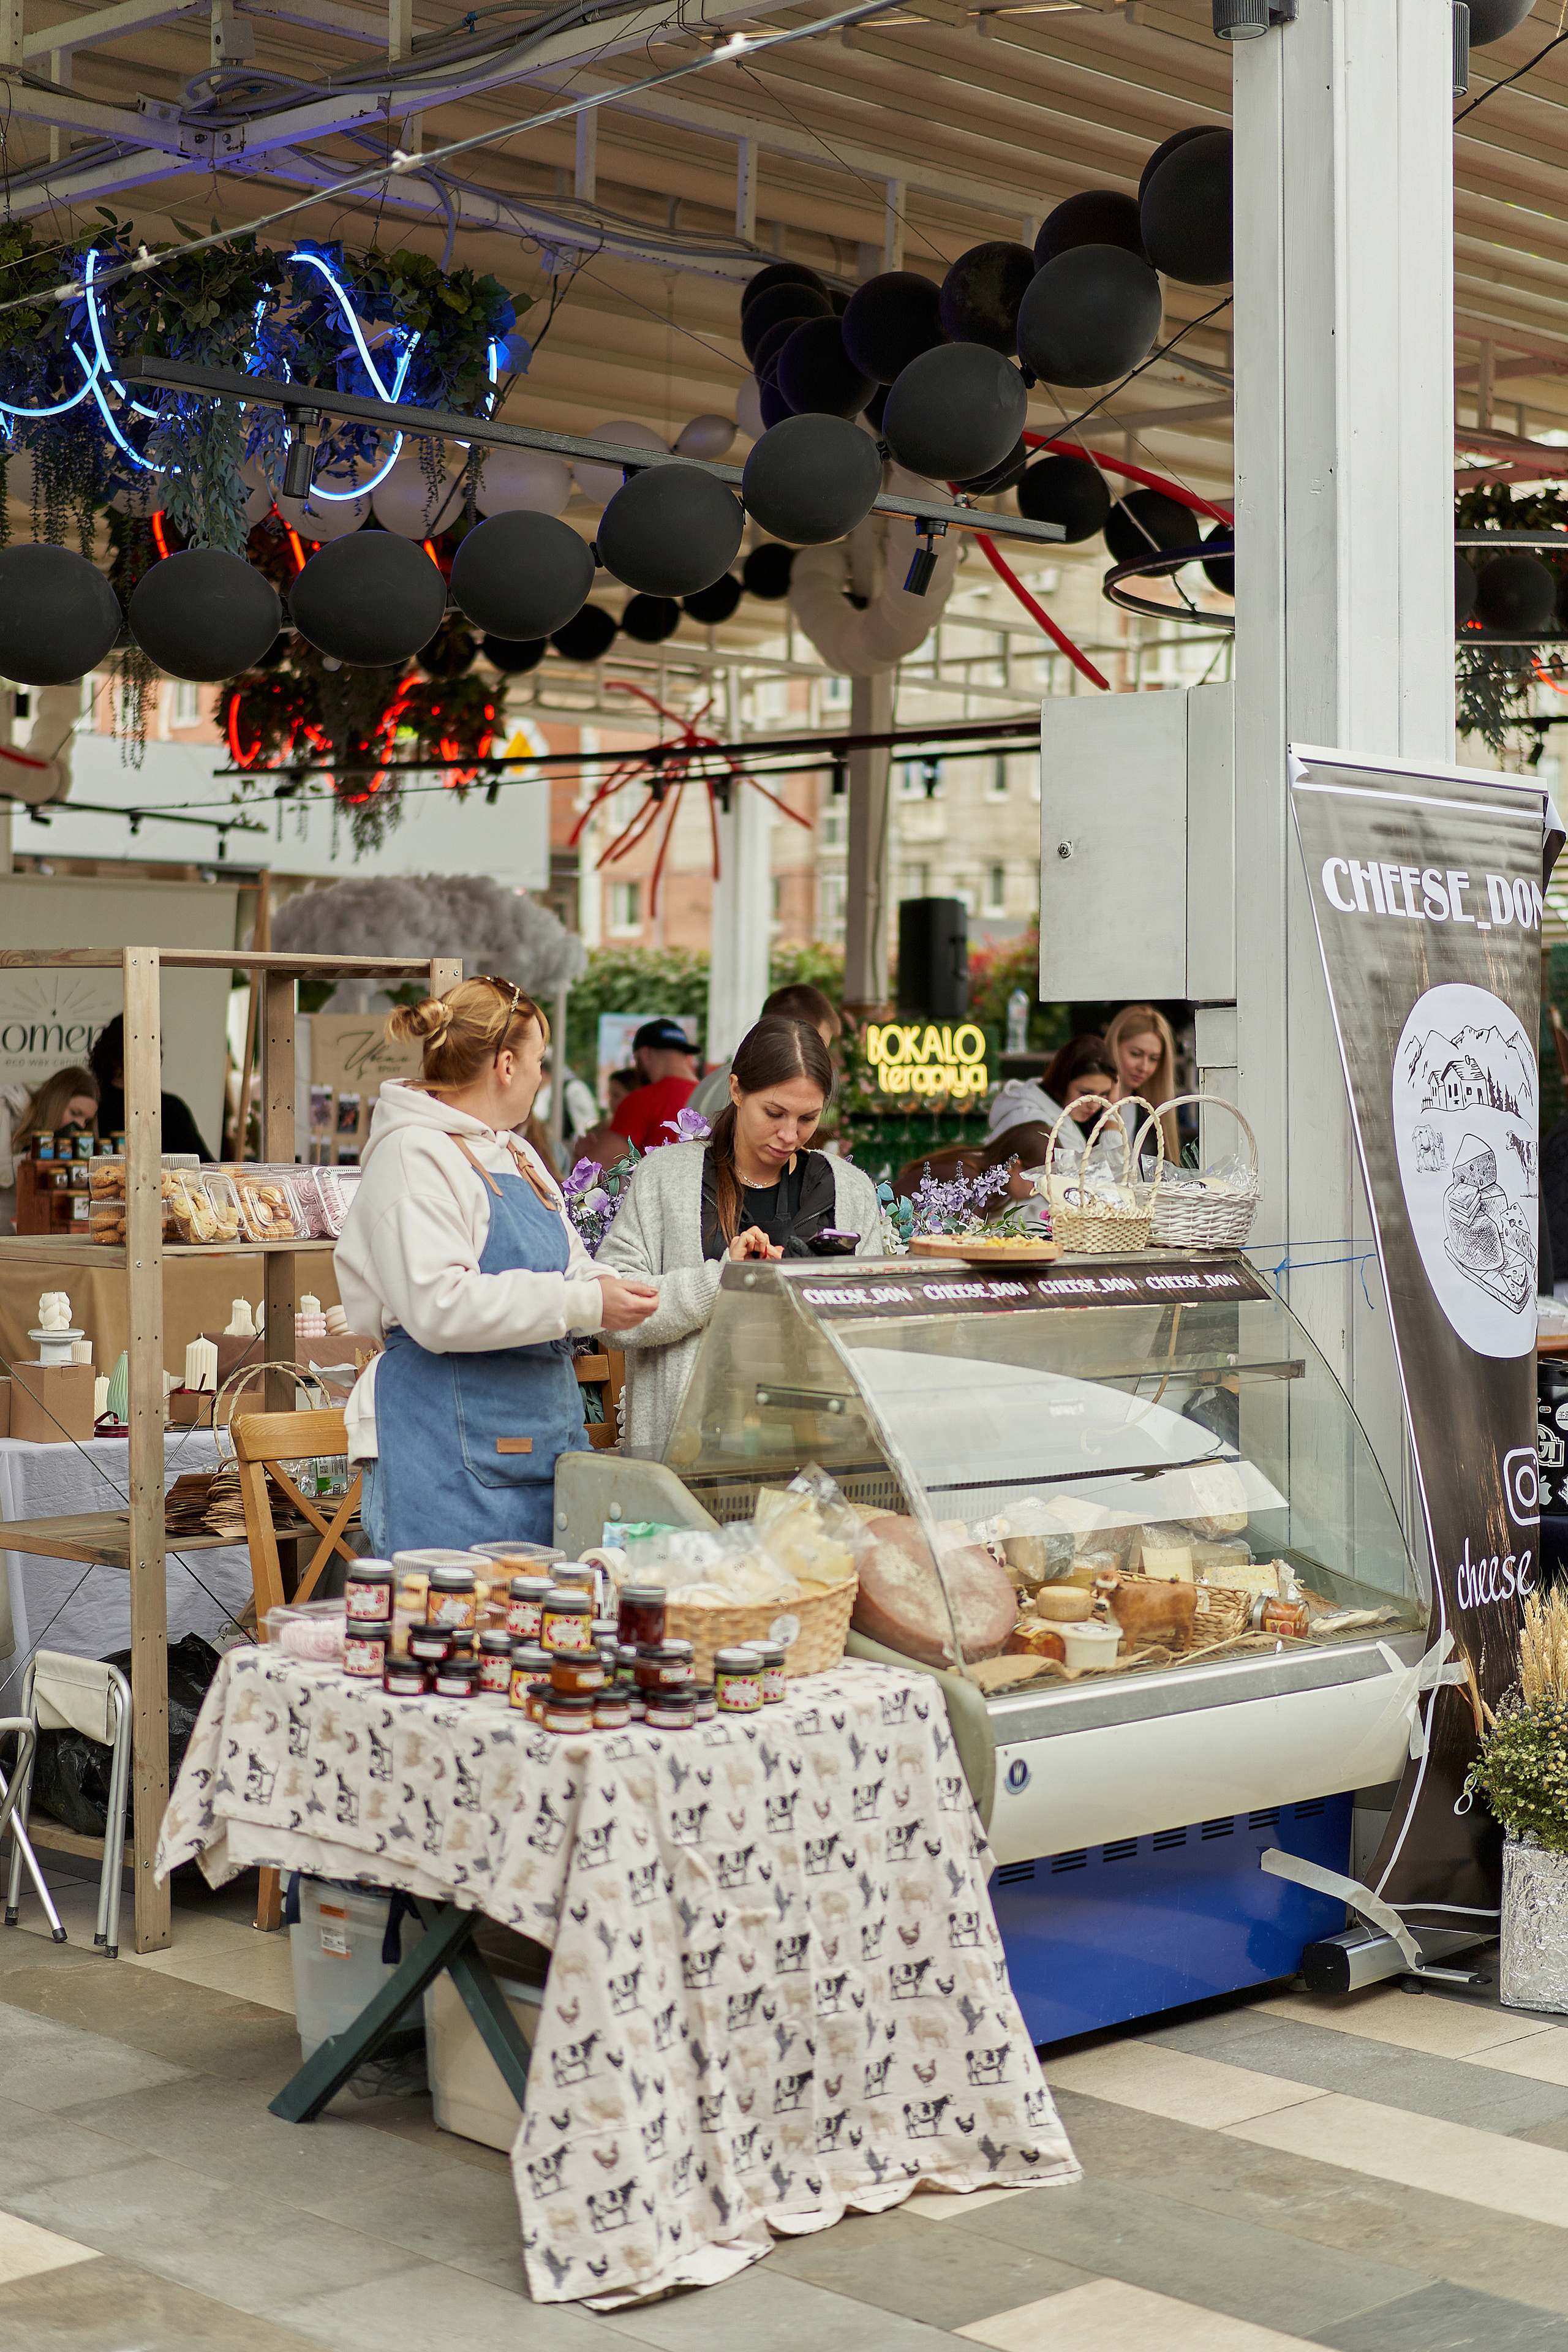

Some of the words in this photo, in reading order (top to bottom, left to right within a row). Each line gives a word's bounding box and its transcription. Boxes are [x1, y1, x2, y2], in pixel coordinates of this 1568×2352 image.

[867, 1024, 986, 1066] BOKALO
[878, 1061, 987, 1098] terapiya
[802, 1287, 914, 1305] CHEESE_DON
[922, 1281, 1030, 1300] CHEESE_DON
[1037, 1277, 1138, 1294] CHEESE_DON
[1144, 1273, 1240, 1290] CHEESE_DON
[1458, 1537, 1536, 1610] cheese
